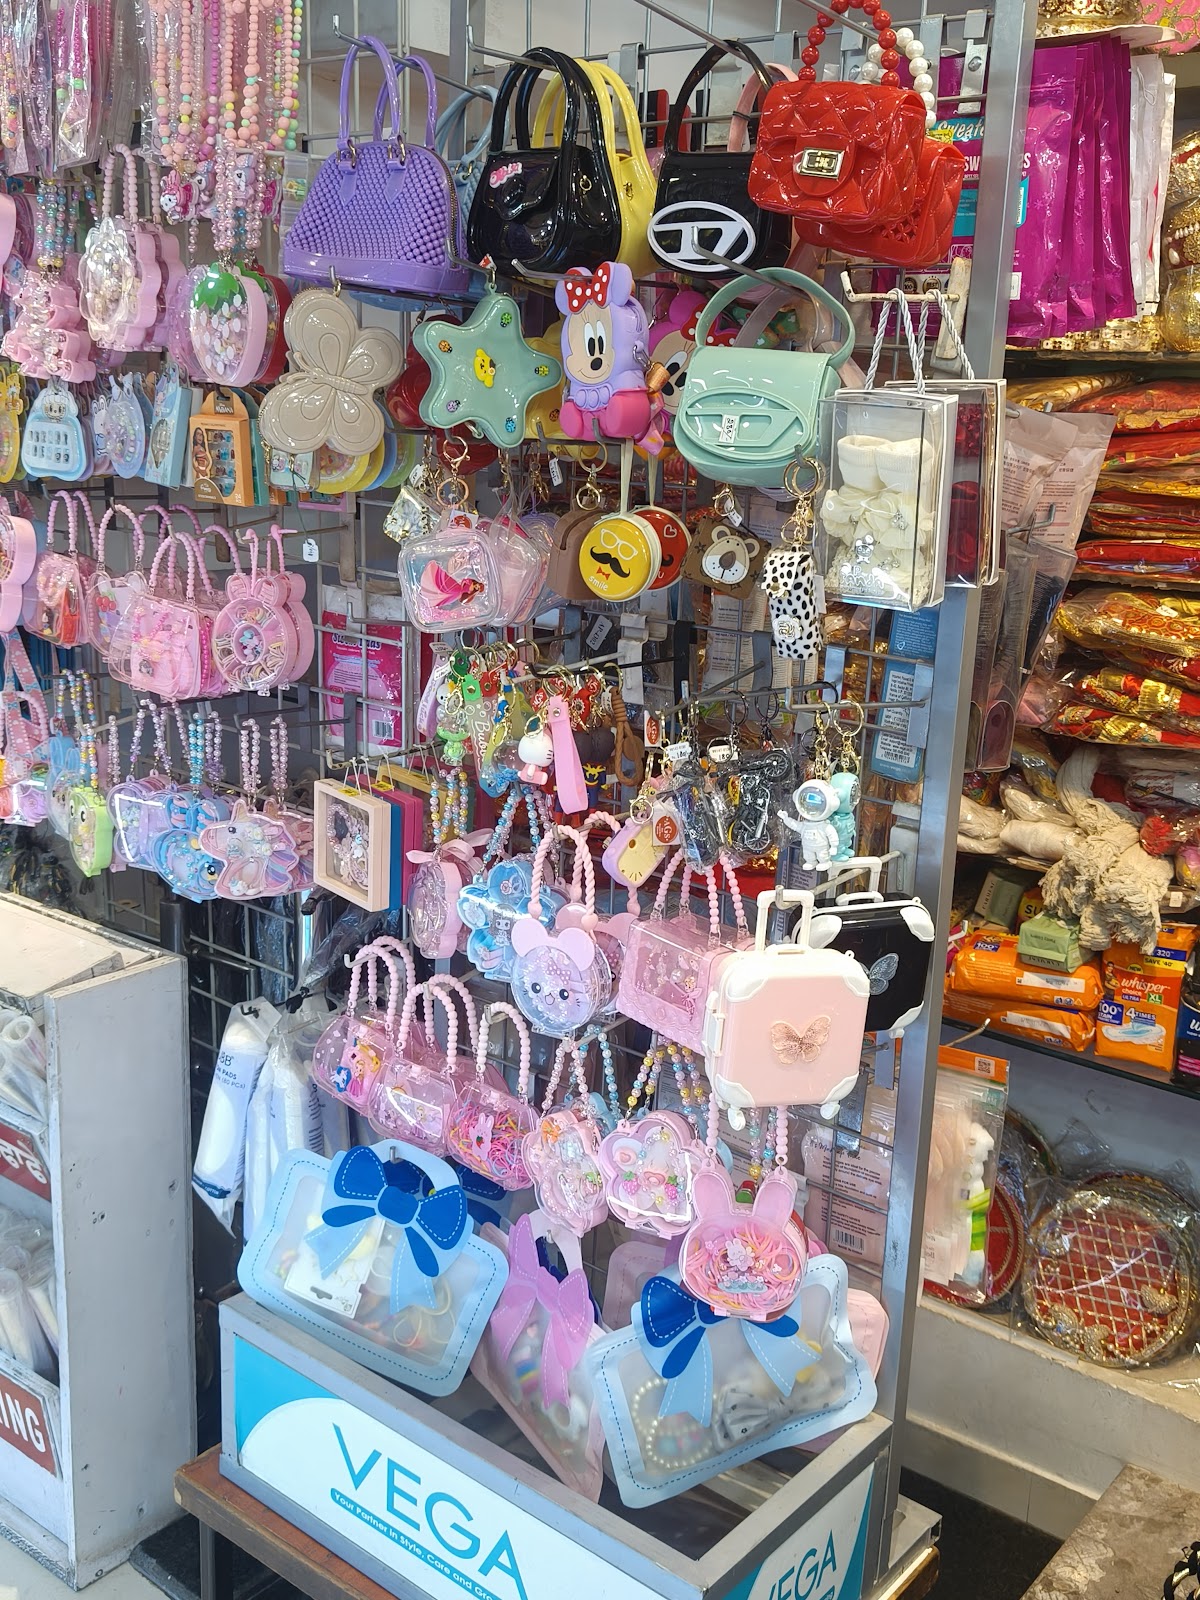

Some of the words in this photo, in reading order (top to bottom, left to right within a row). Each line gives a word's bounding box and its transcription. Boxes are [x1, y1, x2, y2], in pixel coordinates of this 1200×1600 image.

[588, 575, 610, 592] smile
[1120, 976, 1166, 994] whisper
[1148, 993, 1161, 1003] XL
[0, 1389, 46, 1453] ING
[333, 1423, 529, 1600] VEGA
[334, 1491, 354, 1511] Your
[356, 1506, 388, 1533] Partner
[400, 1535, 425, 1559] Style,
[426, 1552, 450, 1575] Care
[452, 1572, 472, 1591] and
